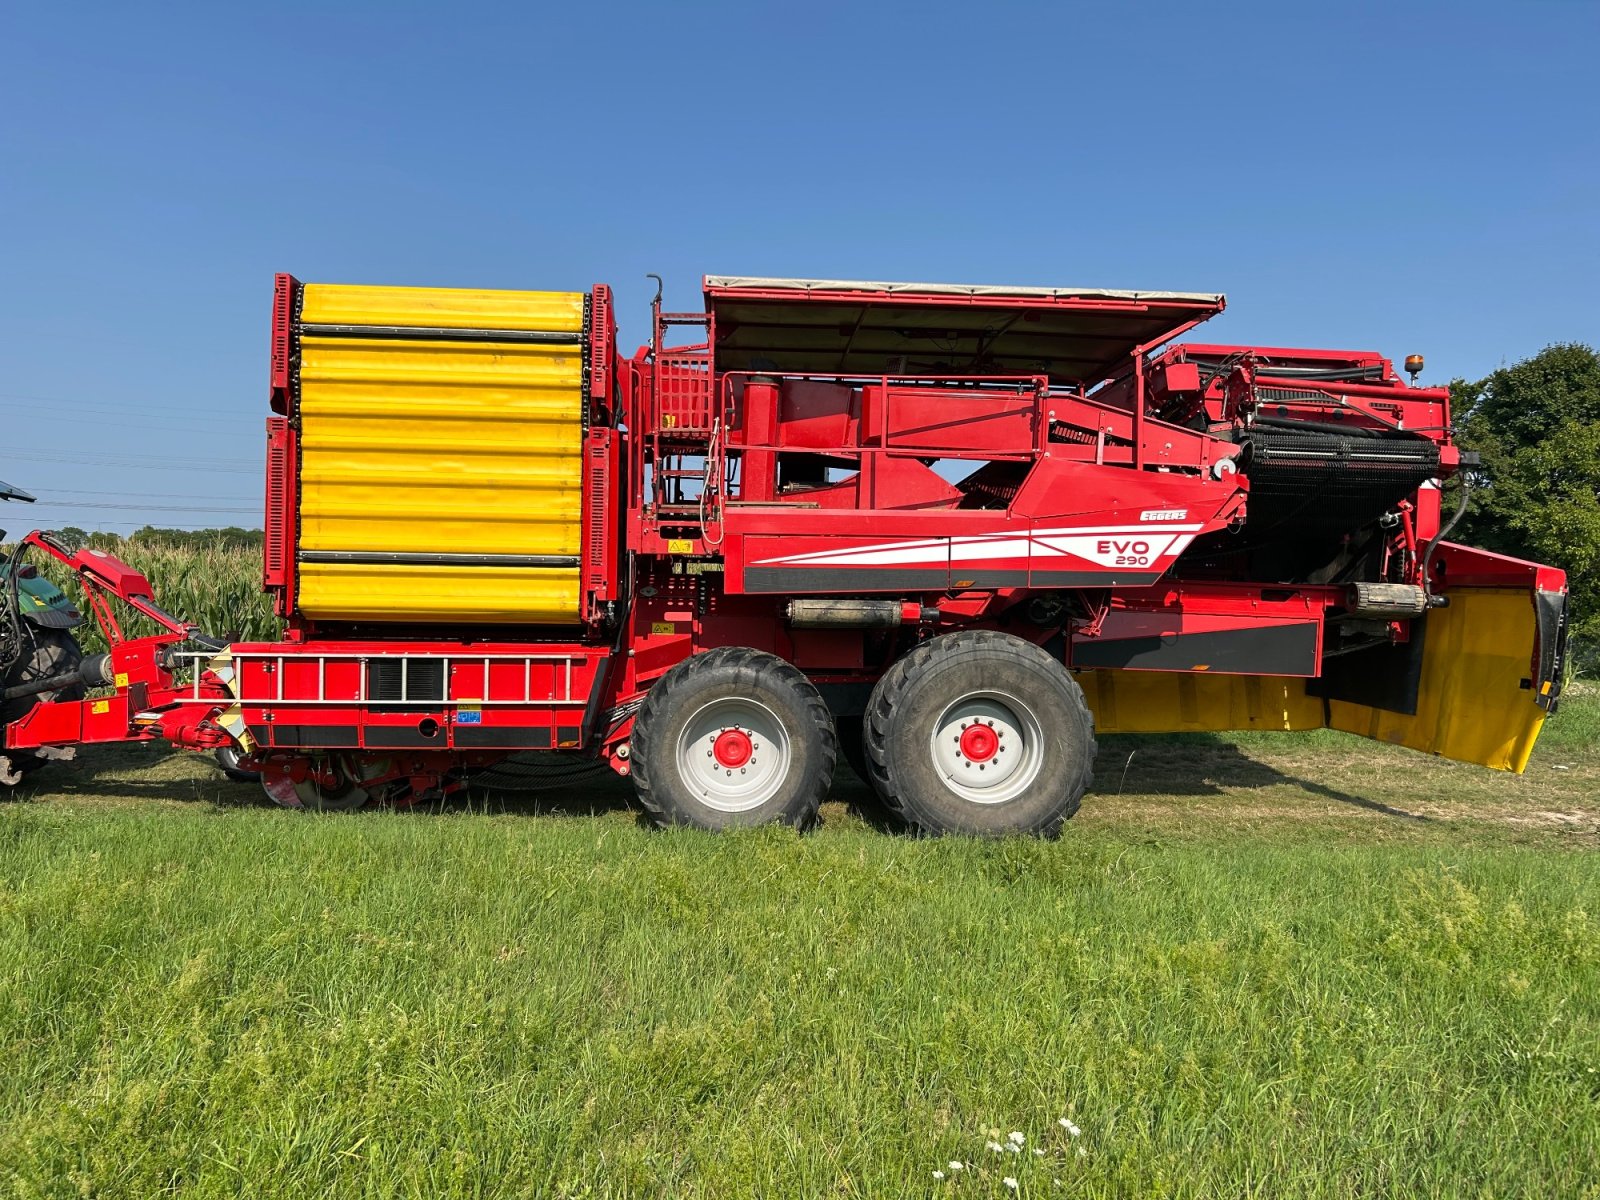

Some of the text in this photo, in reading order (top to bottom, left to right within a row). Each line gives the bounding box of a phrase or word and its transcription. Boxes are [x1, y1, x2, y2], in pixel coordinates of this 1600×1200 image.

[1140, 509, 1188, 521] EGGERS
[1097, 541, 1149, 554] EVO
[1115, 556, 1148, 565] 290
